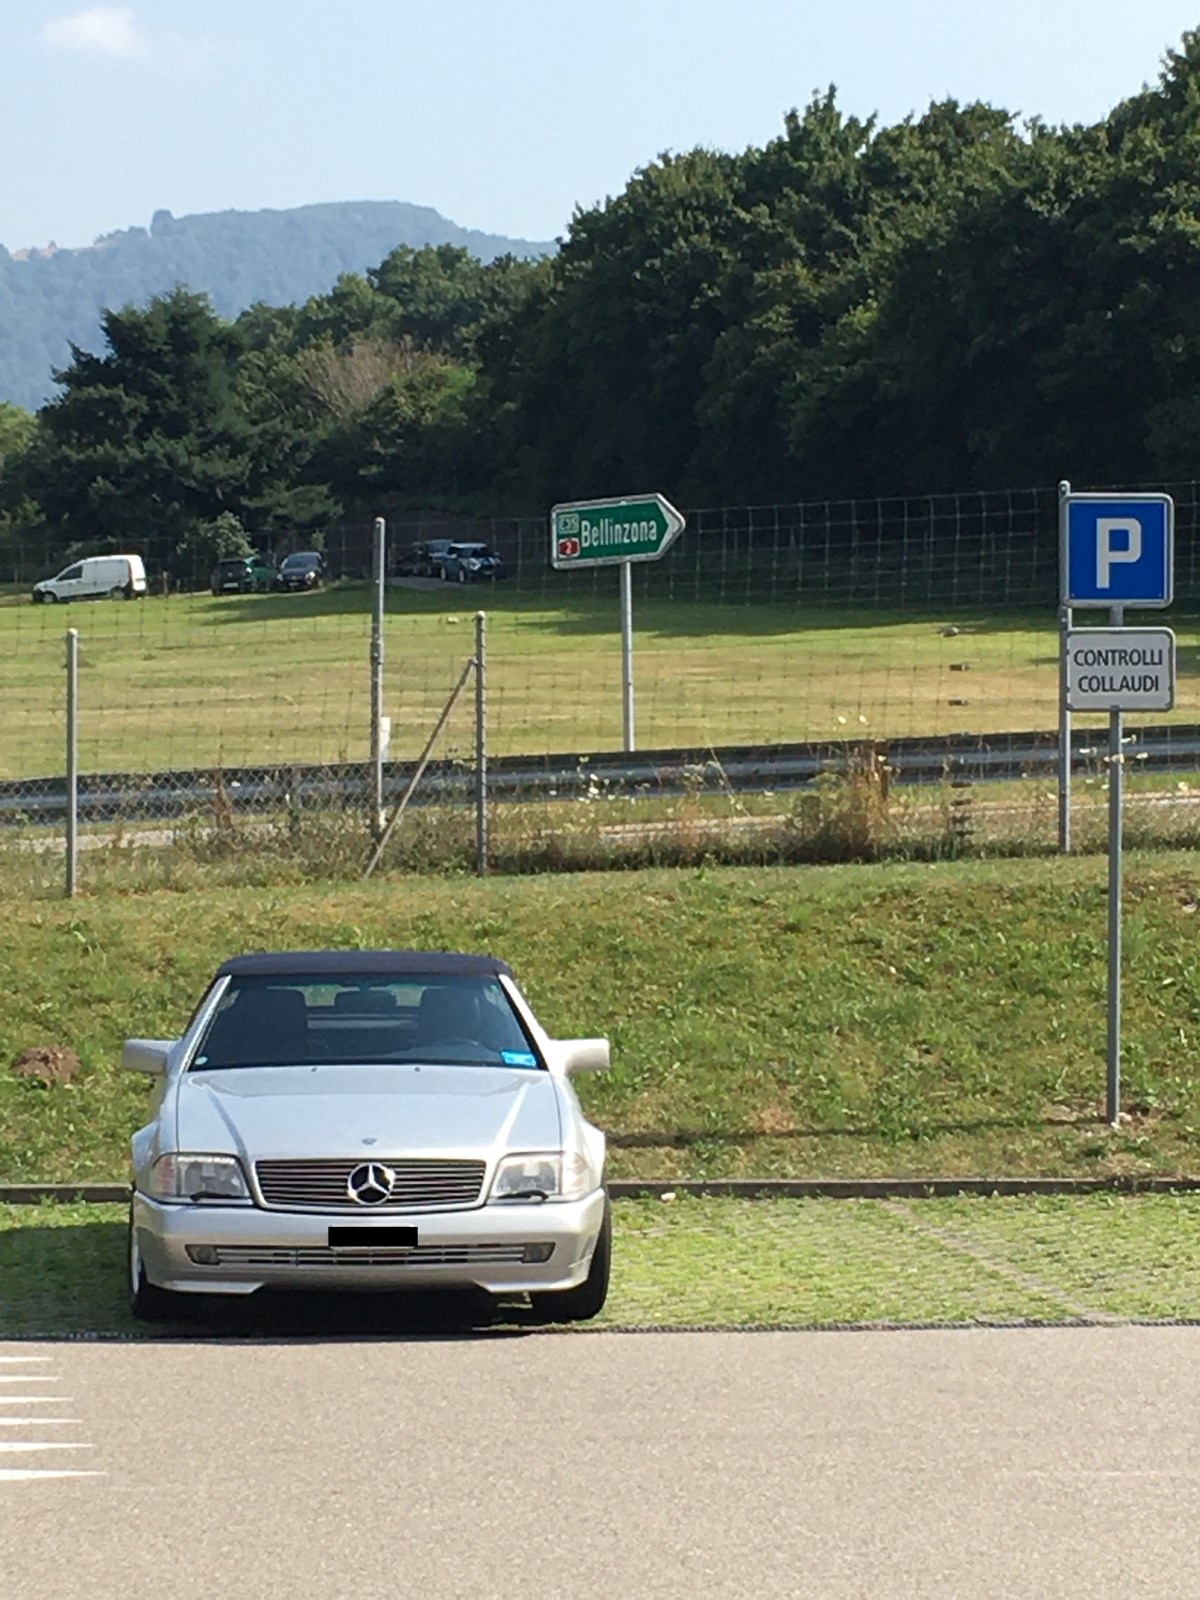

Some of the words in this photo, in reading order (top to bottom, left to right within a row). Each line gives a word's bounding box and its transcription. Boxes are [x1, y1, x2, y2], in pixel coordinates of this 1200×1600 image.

[581, 518, 657, 547] Bellinzona
[1096, 518, 1141, 589] P
[1073, 649, 1163, 667] CONTROLLI
[1078, 675, 1159, 692] COLLAUDI
